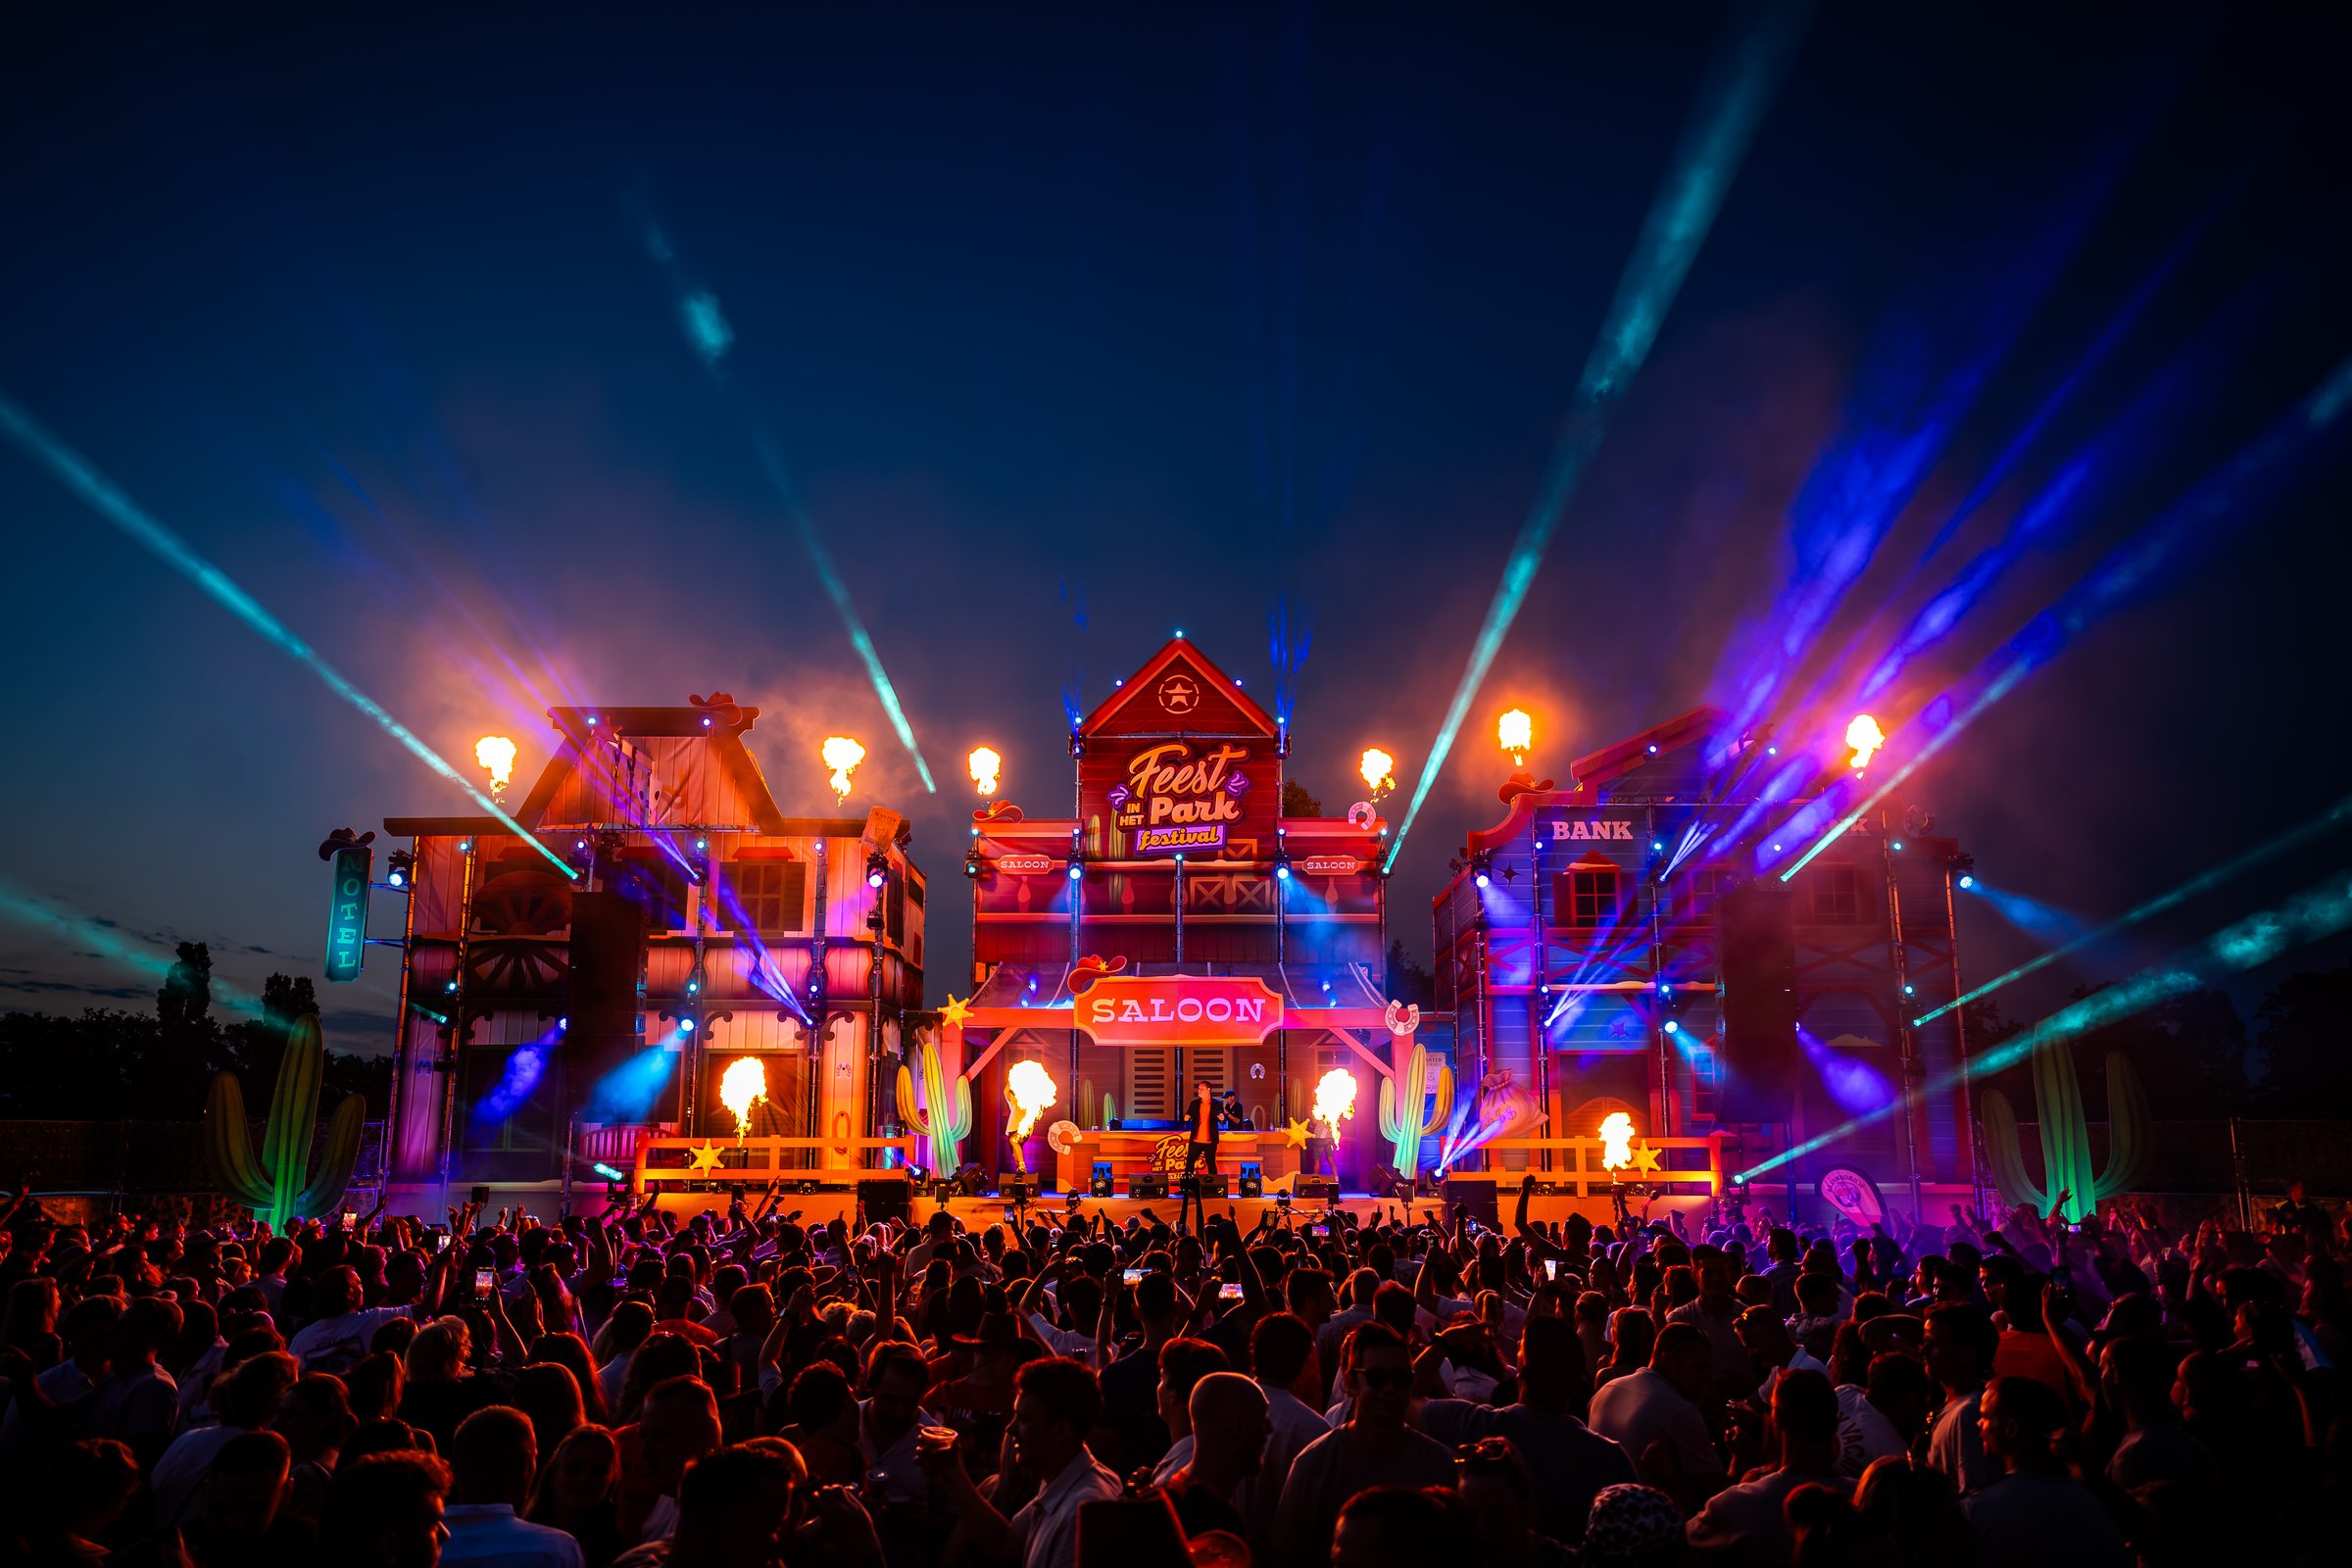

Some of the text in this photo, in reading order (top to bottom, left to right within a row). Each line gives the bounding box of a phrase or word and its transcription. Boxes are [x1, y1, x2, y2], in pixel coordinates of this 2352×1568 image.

[1128, 744, 1248, 799] Feest
[1119, 814, 1145, 827] HET
[1126, 791, 1240, 825] IN Park
[1138, 825, 1219, 852] festival
[1551, 820, 1634, 840] BANK
[1000, 860, 1050, 869] SALOON
[336, 854, 365, 968] MOTEL
[1092, 997, 1266, 1023] SALOON
[1155, 1135, 1190, 1160] Fees
[1165, 1157, 1205, 1171] Pak
